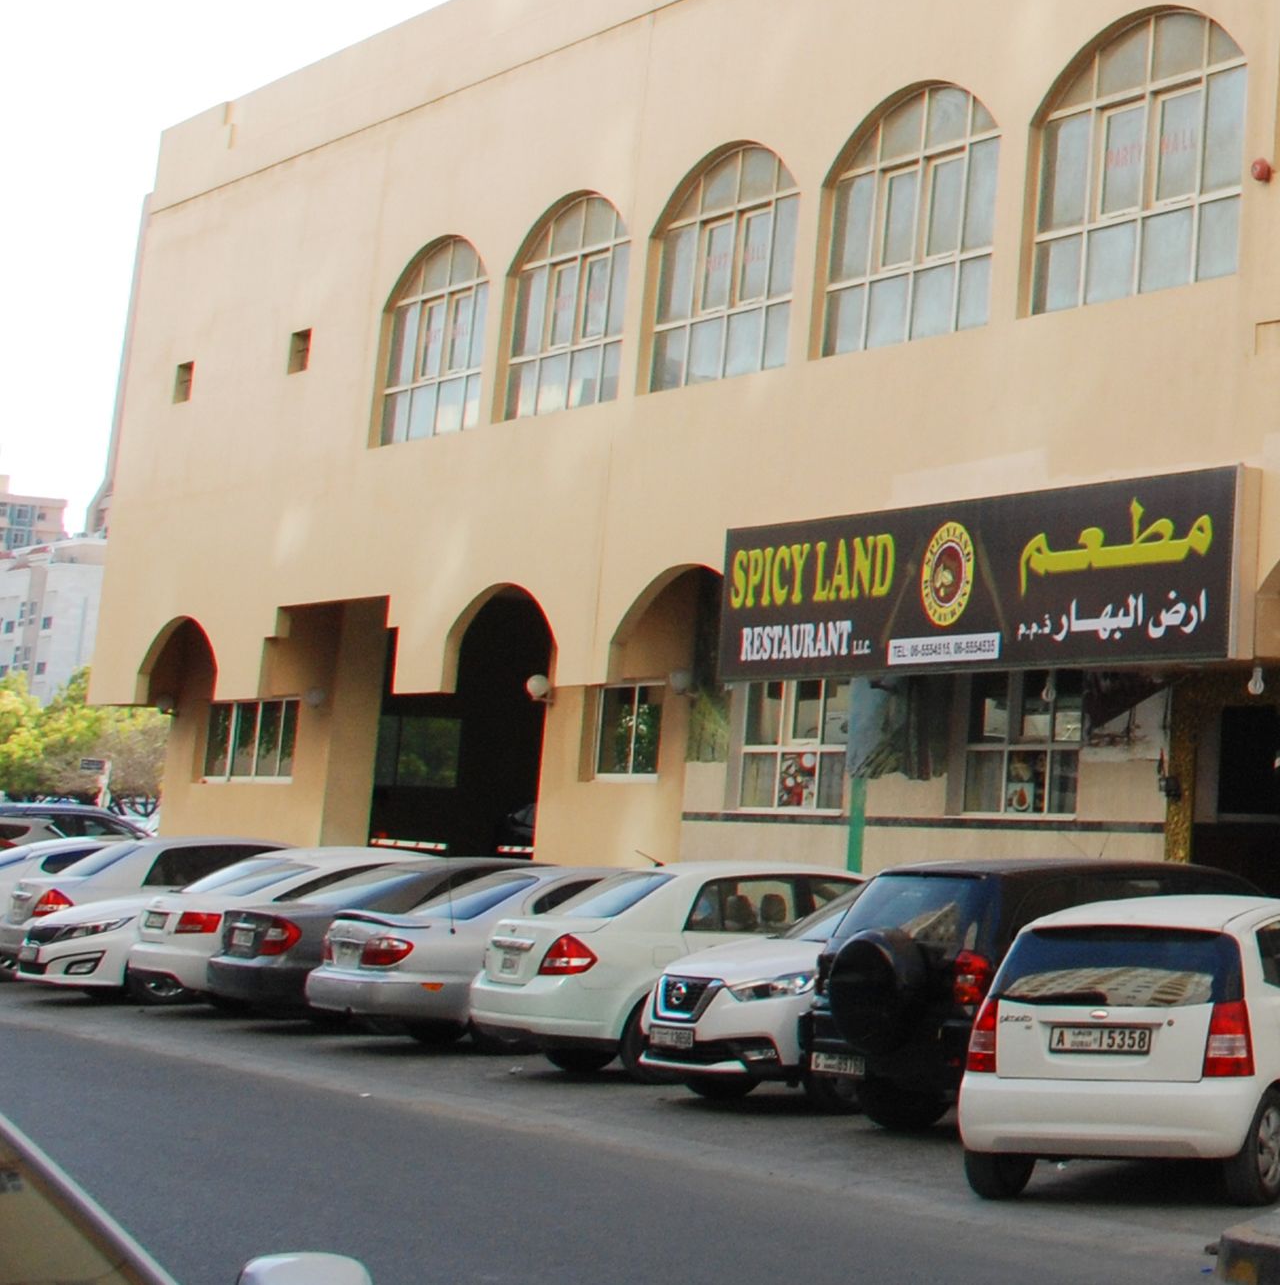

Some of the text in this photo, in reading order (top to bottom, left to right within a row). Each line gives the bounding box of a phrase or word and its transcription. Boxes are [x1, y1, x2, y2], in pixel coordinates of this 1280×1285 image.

[731, 533, 896, 609] SPICY LAND
[1020, 496, 1213, 599] مطعم
[740, 619, 852, 662] RESTAURANT
[1052, 592, 1144, 642] البهار
[1056, 1029, 1065, 1047] A
[1099, 1030, 1147, 1049] 15358
